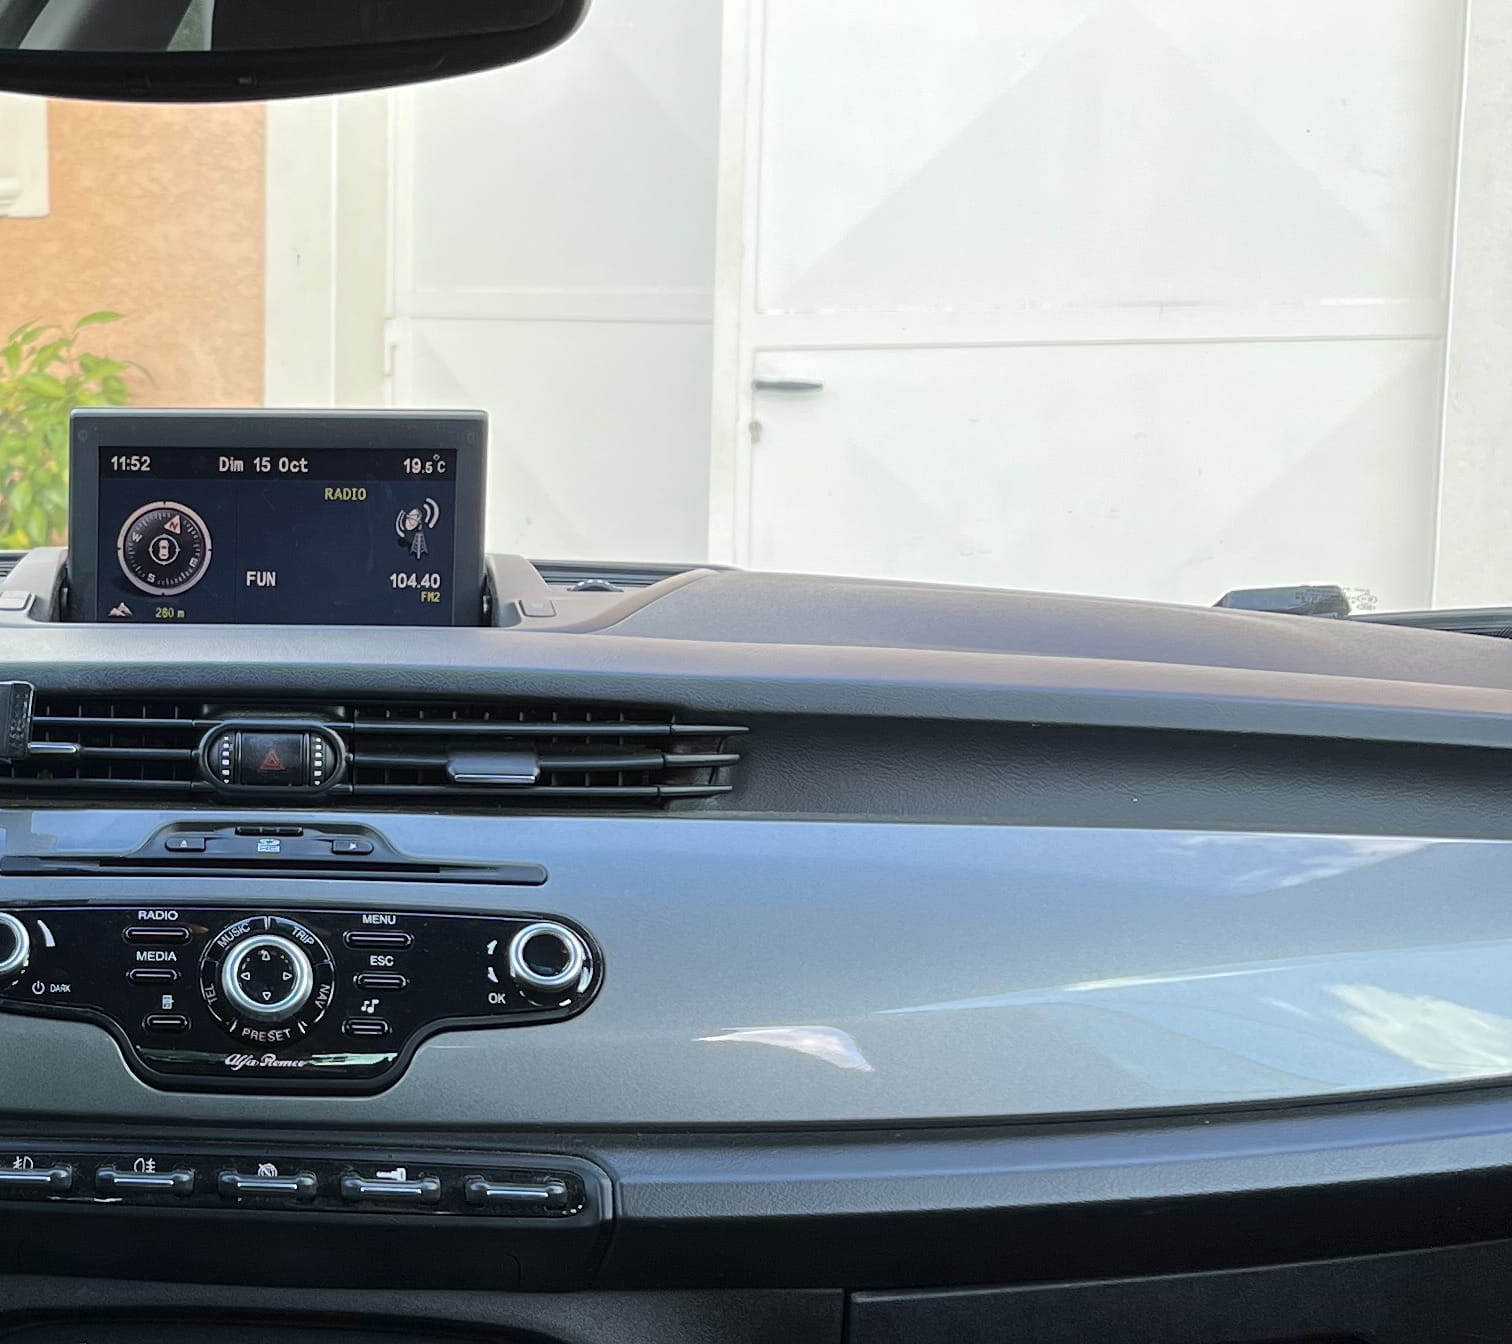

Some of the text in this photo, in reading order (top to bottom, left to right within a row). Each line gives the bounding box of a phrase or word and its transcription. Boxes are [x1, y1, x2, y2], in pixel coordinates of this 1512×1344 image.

[111, 456, 151, 471] 11:52
[219, 456, 309, 473] Dim 15 Oct
[324, 487, 367, 501] RADIO
[146, 573, 156, 583] S
[246, 571, 276, 587] FUN
[390, 572, 441, 589] 104.40
[420, 591, 441, 603] FM2
[137, 910, 179, 921] RADIO
[362, 914, 397, 925] MENU
[216, 922, 251, 948] MUSIC
[291, 925, 315, 946] TRIP
[136, 951, 177, 961] MEDIA
[369, 955, 394, 966] ESC
[49, 983, 71, 993] DARK
[204, 983, 218, 1006] TEL
[314, 983, 331, 1009] NAV
[488, 993, 506, 1004] OK
[241, 1028, 291, 1042] PRESET
[224, 1053, 306, 1071] Alfa Romeo
